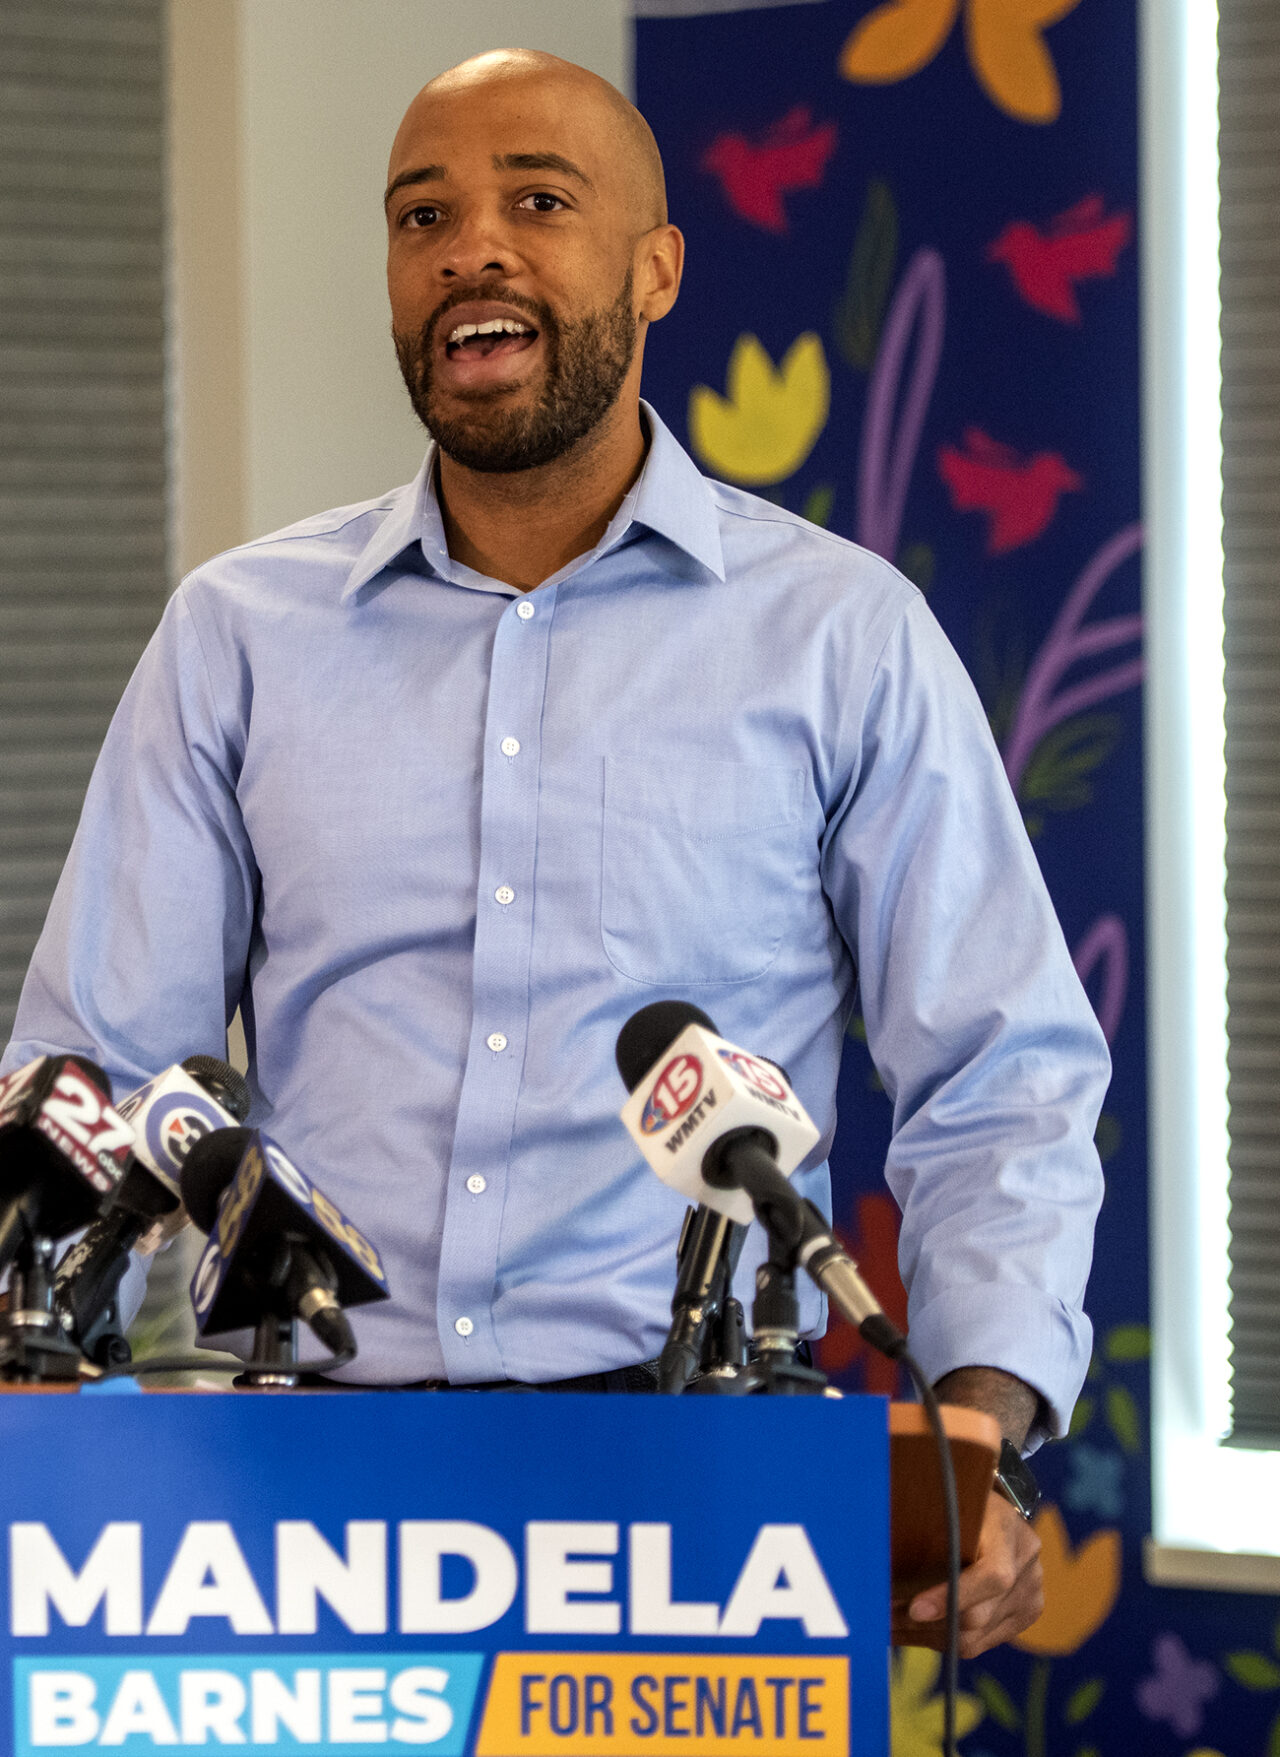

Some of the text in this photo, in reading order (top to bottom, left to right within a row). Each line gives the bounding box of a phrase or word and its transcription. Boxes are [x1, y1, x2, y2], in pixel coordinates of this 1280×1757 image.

[42, 1075, 136, 1155] 27
[657, 1058, 698, 1116] 15
[665, 1088, 717, 1154] WMTV
[745, 1085, 801, 1122] WMTV
[38, 1118, 112, 1192] NEWS
[10, 1520, 849, 1637] MANDELA
[29, 1666, 454, 1746] BARNES
[521, 1674, 826, 1739] FOR SENATE
